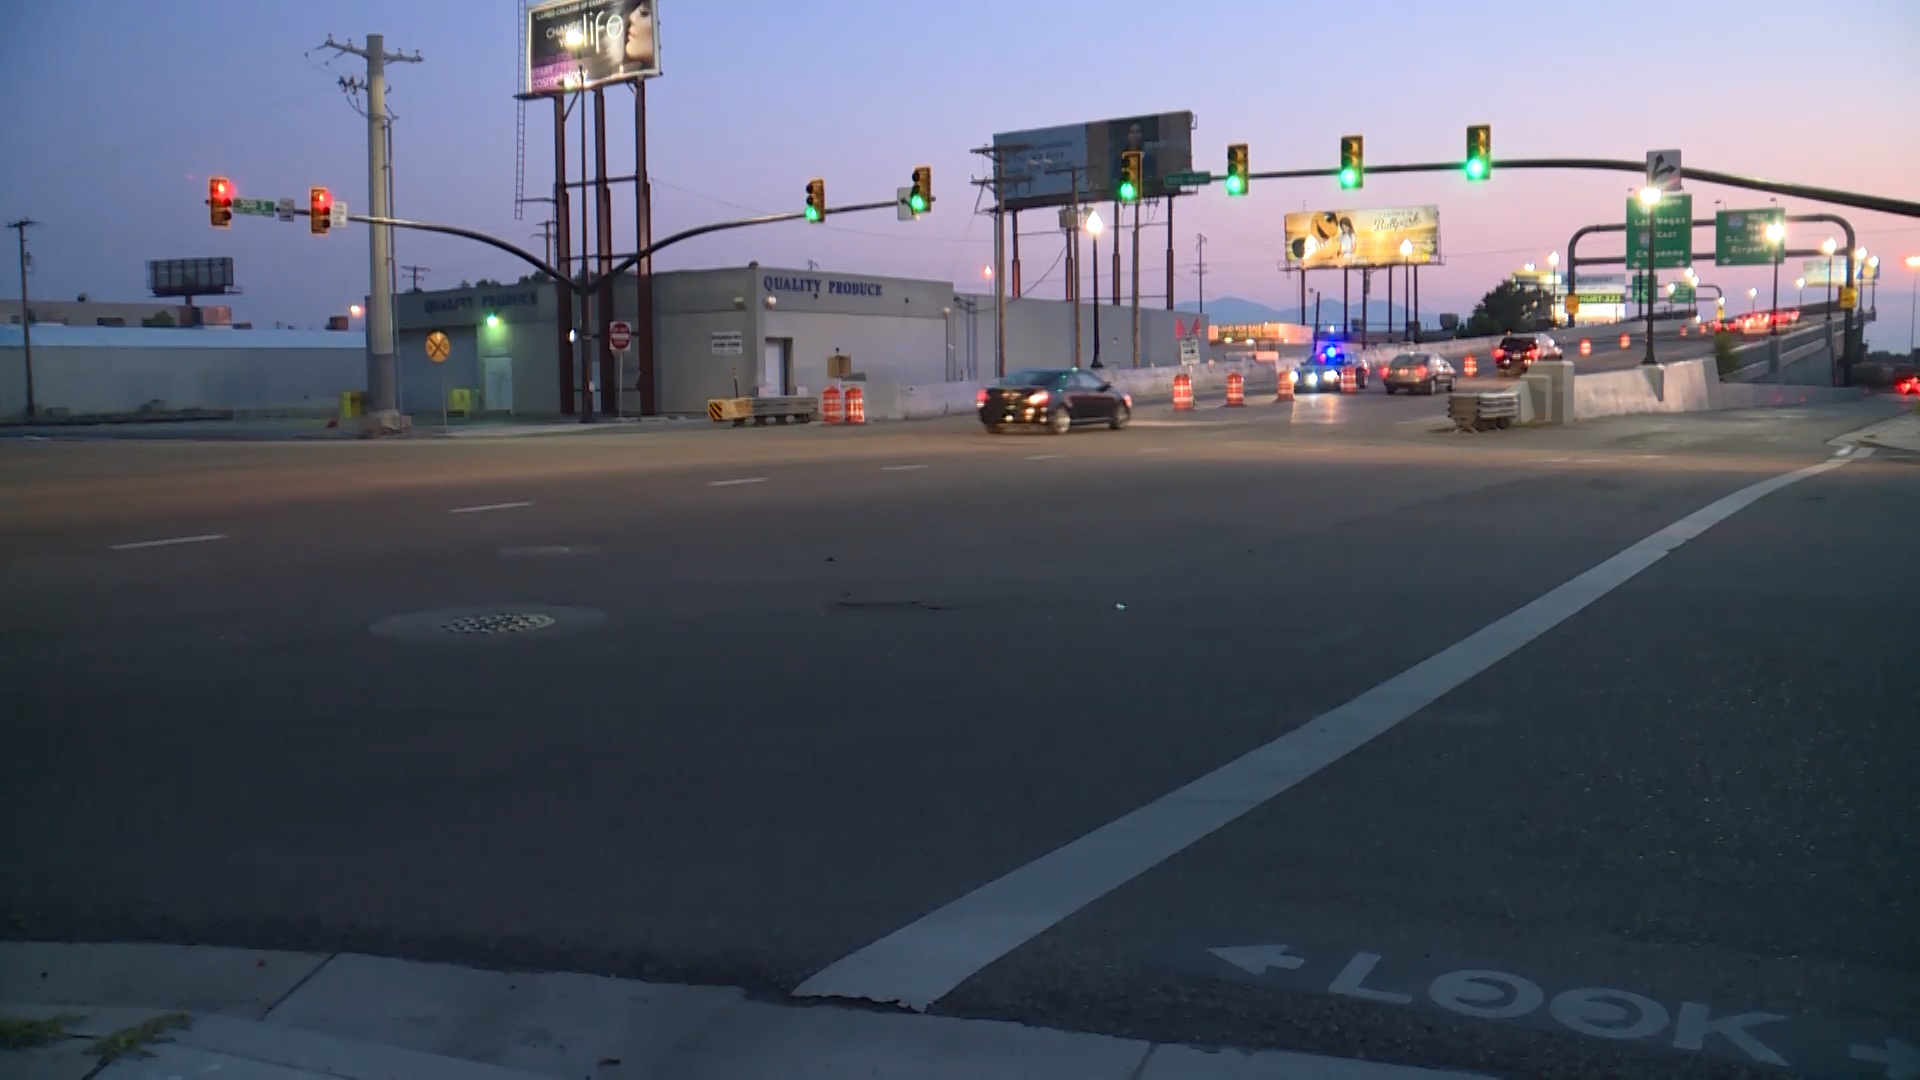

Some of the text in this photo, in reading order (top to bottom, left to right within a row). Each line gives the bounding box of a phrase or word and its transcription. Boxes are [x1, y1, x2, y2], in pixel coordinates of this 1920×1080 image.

[1656, 217, 1686, 228] Vegas
[1636, 249, 1684, 259] Chyenne
[763, 275, 882, 296] QUALITY PRODUCE
[1328, 951, 1791, 1066] LOOK
